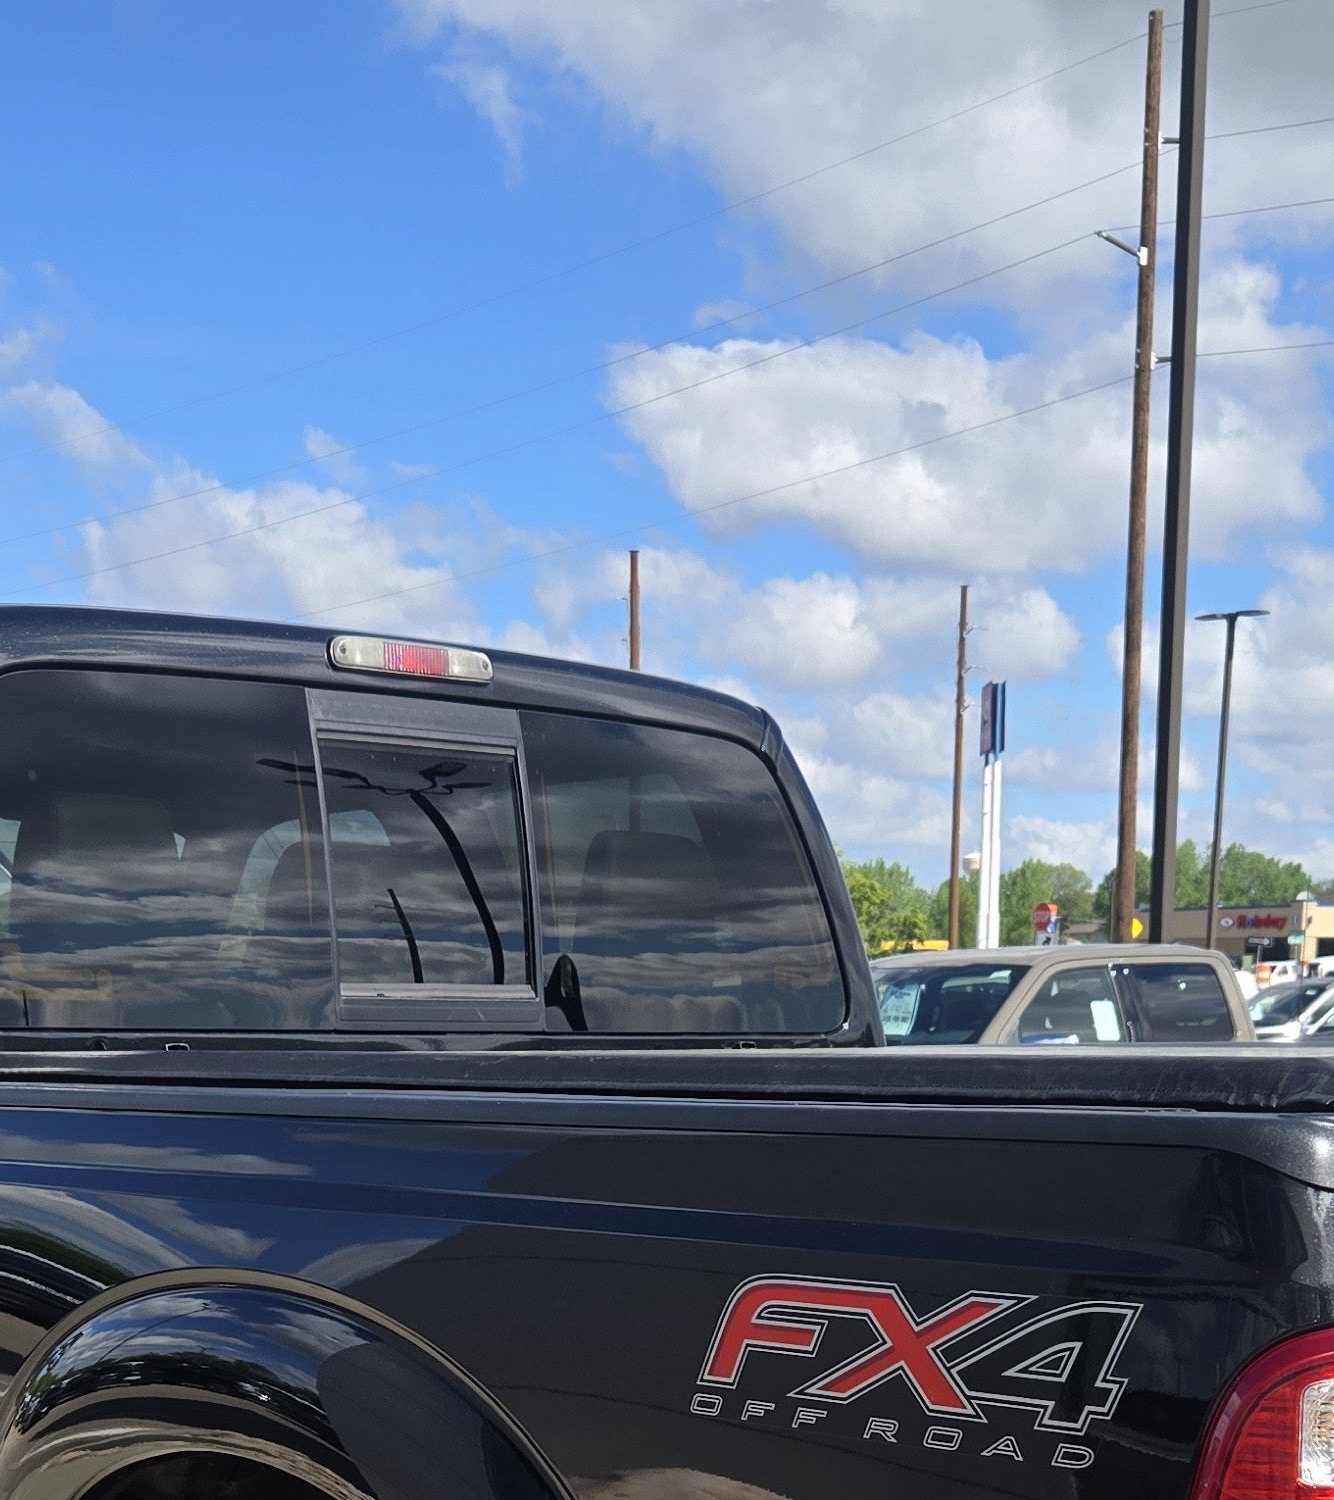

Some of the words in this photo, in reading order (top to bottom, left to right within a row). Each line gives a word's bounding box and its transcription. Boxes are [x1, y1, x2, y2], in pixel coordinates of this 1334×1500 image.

[696, 1272, 1145, 1436] FX4
[689, 1391, 829, 1430] OFF
[862, 1416, 1096, 1470] ROAD
